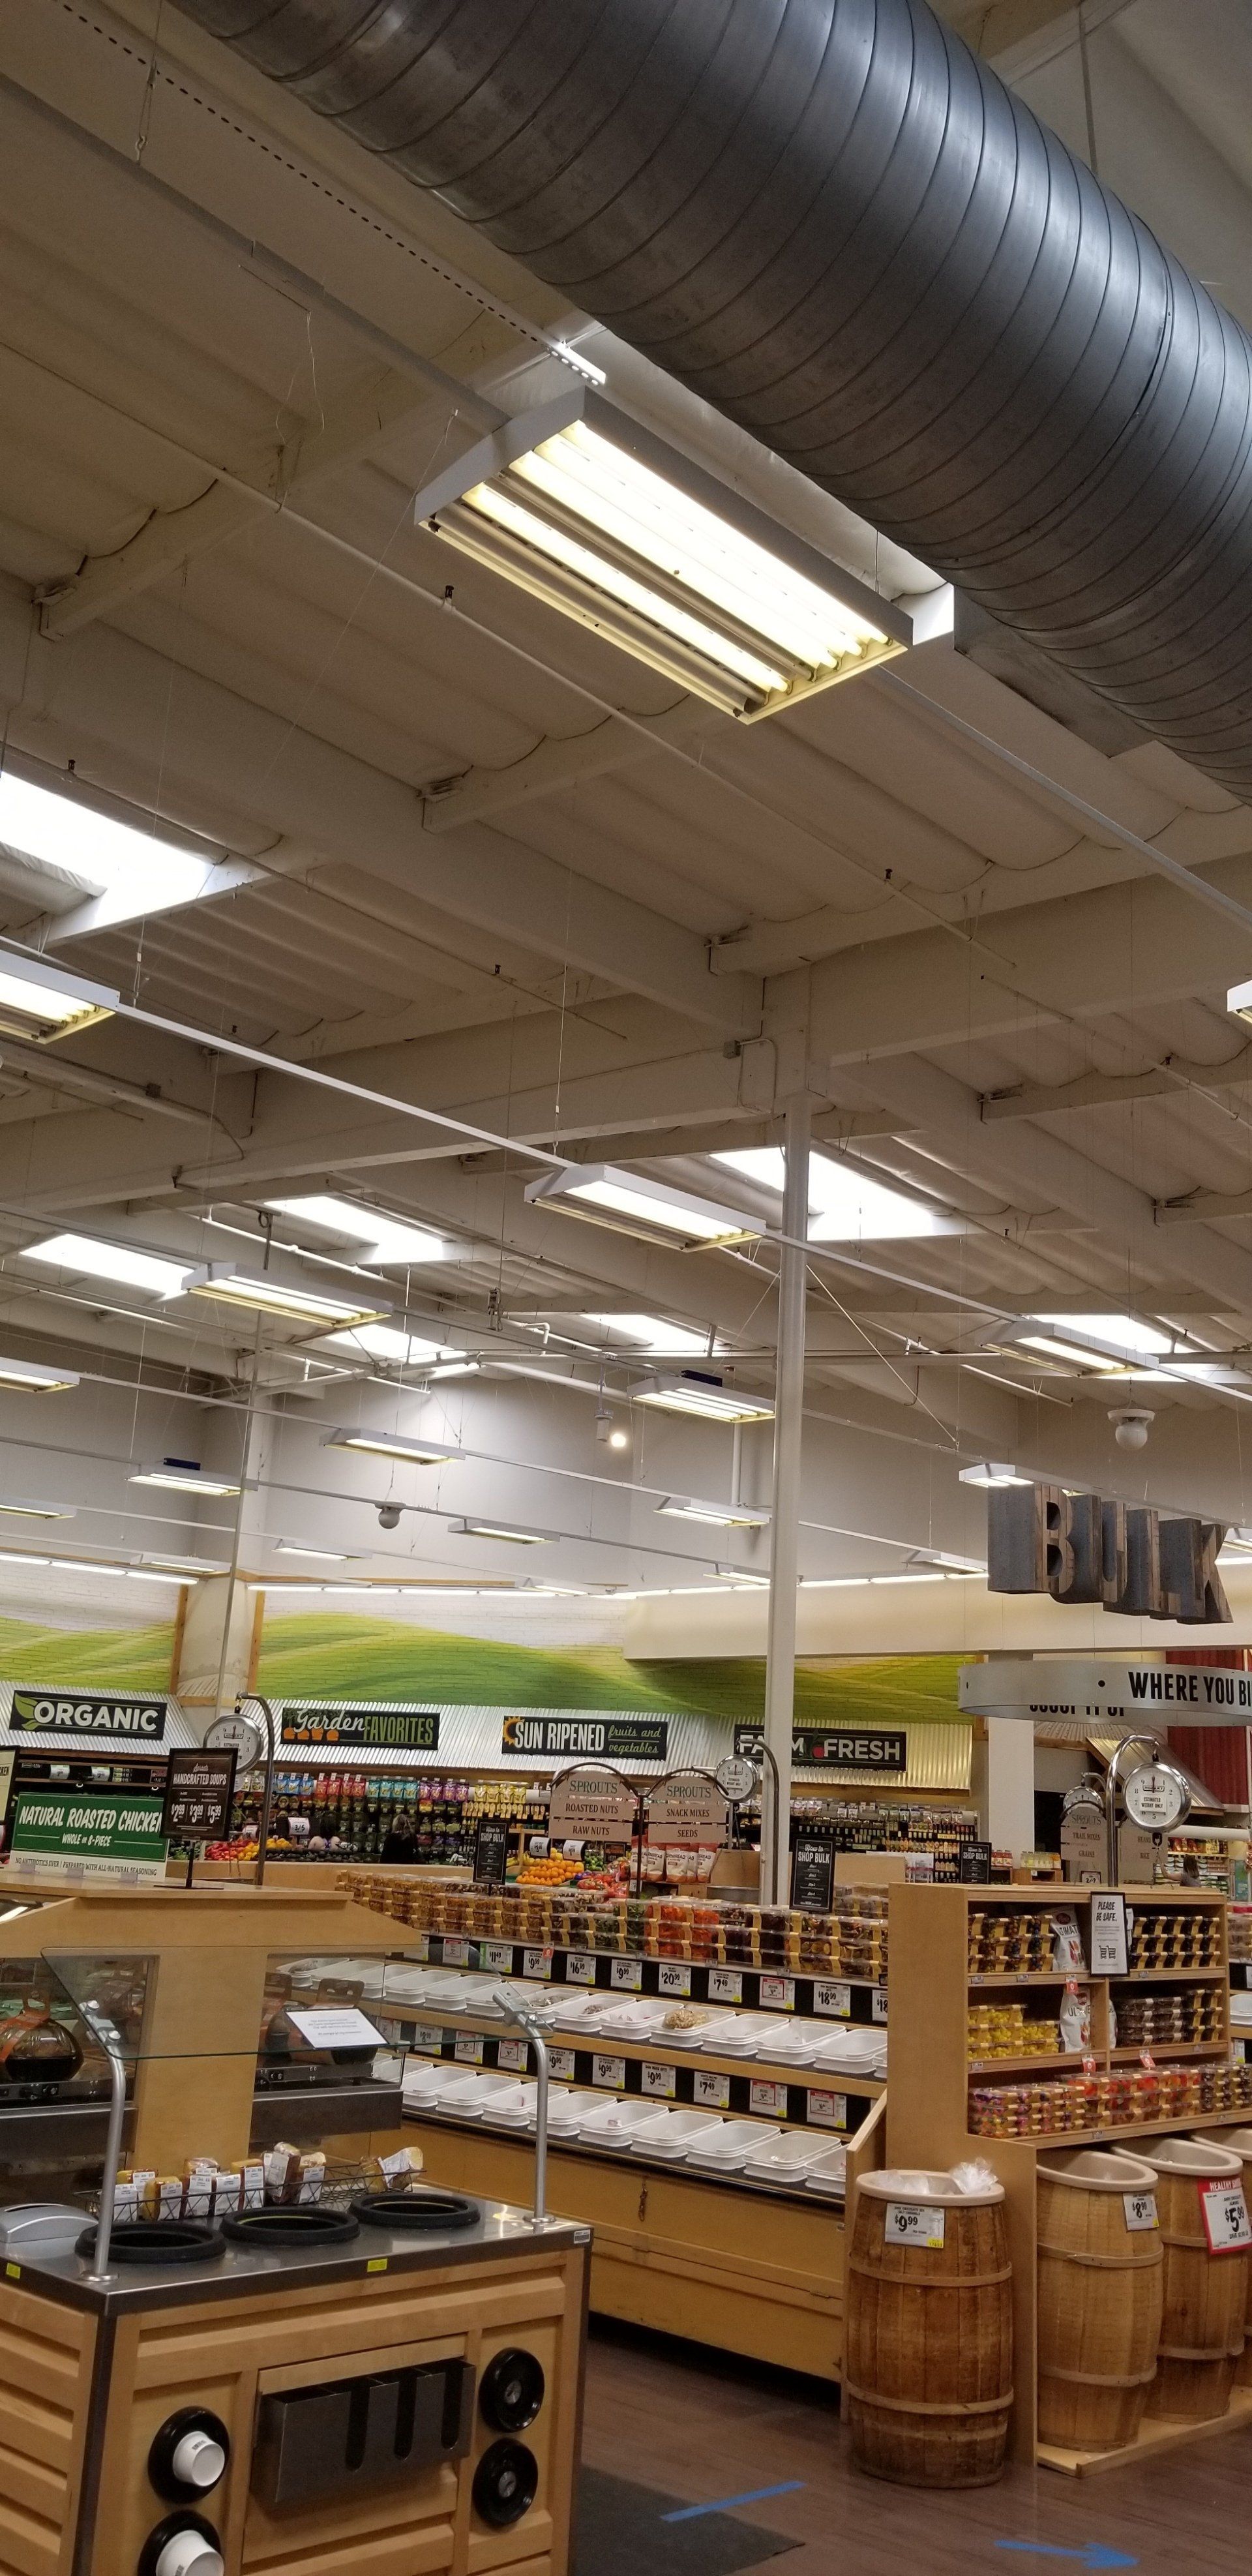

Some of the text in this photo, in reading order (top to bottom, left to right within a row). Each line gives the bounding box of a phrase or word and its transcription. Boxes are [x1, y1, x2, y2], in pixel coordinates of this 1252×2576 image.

[1034, 1482, 1233, 1624] BULK
[1128, 1671, 1199, 1702] WHERE
[1203, 1676, 1234, 1705] YOU
[34, 1700, 158, 1731] ORGANIC
[293, 1708, 434, 1743] Garden FAVORITES
[514, 1721, 661, 1751] SUN RIPENED fruits and
[608, 1742, 659, 1754] vegetables
[824, 1738, 900, 1761] FRESH
[173, 1773, 227, 1786] HANDCRAFTED SOUPS
[569, 1780, 618, 1795] SPROUTS
[666, 1785, 711, 1799] SPROUTS
[565, 1803, 619, 1814] ROASTED NUTS
[666, 1808, 710, 1818] SNACK MIXES
[18, 1805, 65, 1826] NATURAL
[67, 1808, 117, 1830] ROASTED
[1071, 1814, 1101, 1825] SPROUTS
[573, 1825, 610, 1836] RAW NUTS
[677, 1829, 698, 1838] SEEDS
[62, 1833, 82, 1845] WHOLE
[87, 1835, 112, 1847] 8-PIECE
[481, 1833, 505, 1842] SHOP BULK
[805, 1844, 818, 1852] How
[797, 1851, 830, 1864] SHOP BULK
[98, 1864, 129, 1874] ALL-NATURAL
[1097, 1901, 1116, 1911] PLEASE
[1096, 1912, 1117, 1922] BE SAFE.
[1209, 2180, 1232, 2192] HEALTHY
